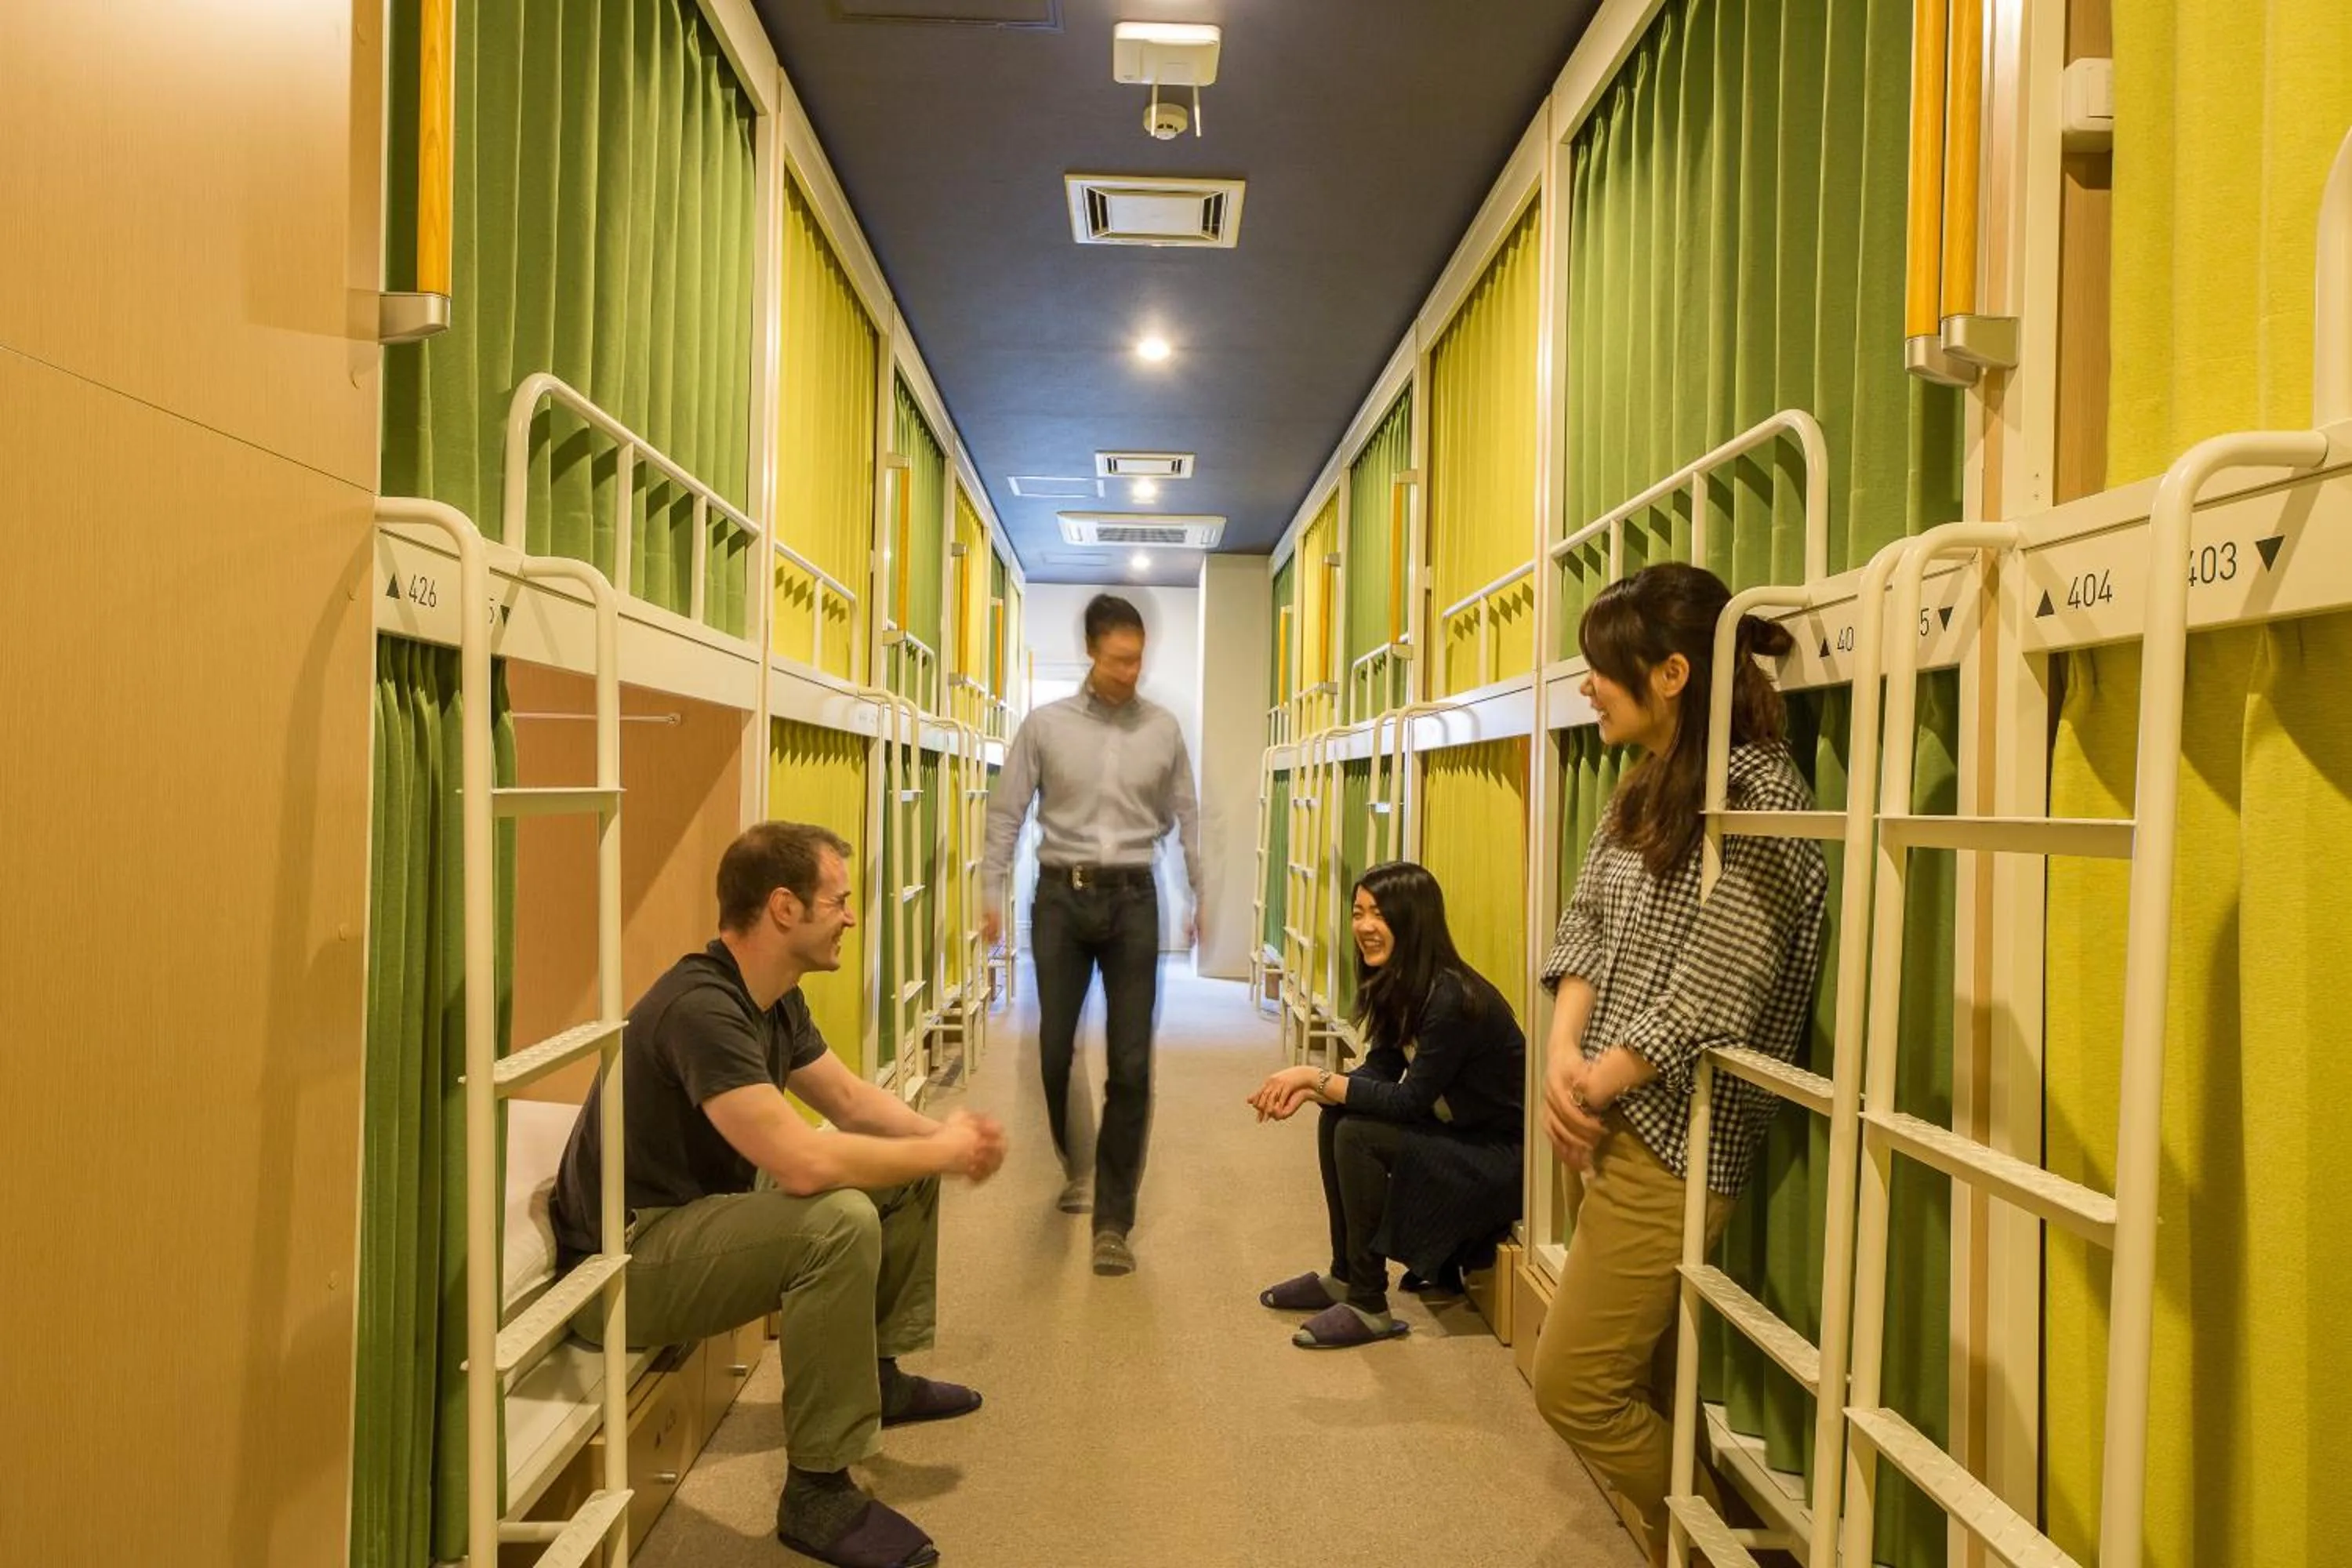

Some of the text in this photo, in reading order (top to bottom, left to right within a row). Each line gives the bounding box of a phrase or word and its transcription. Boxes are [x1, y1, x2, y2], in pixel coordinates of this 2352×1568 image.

[408, 573, 437, 608] 426
[2067, 568, 2113, 609] 404
[1837, 626, 1854, 652] 40
